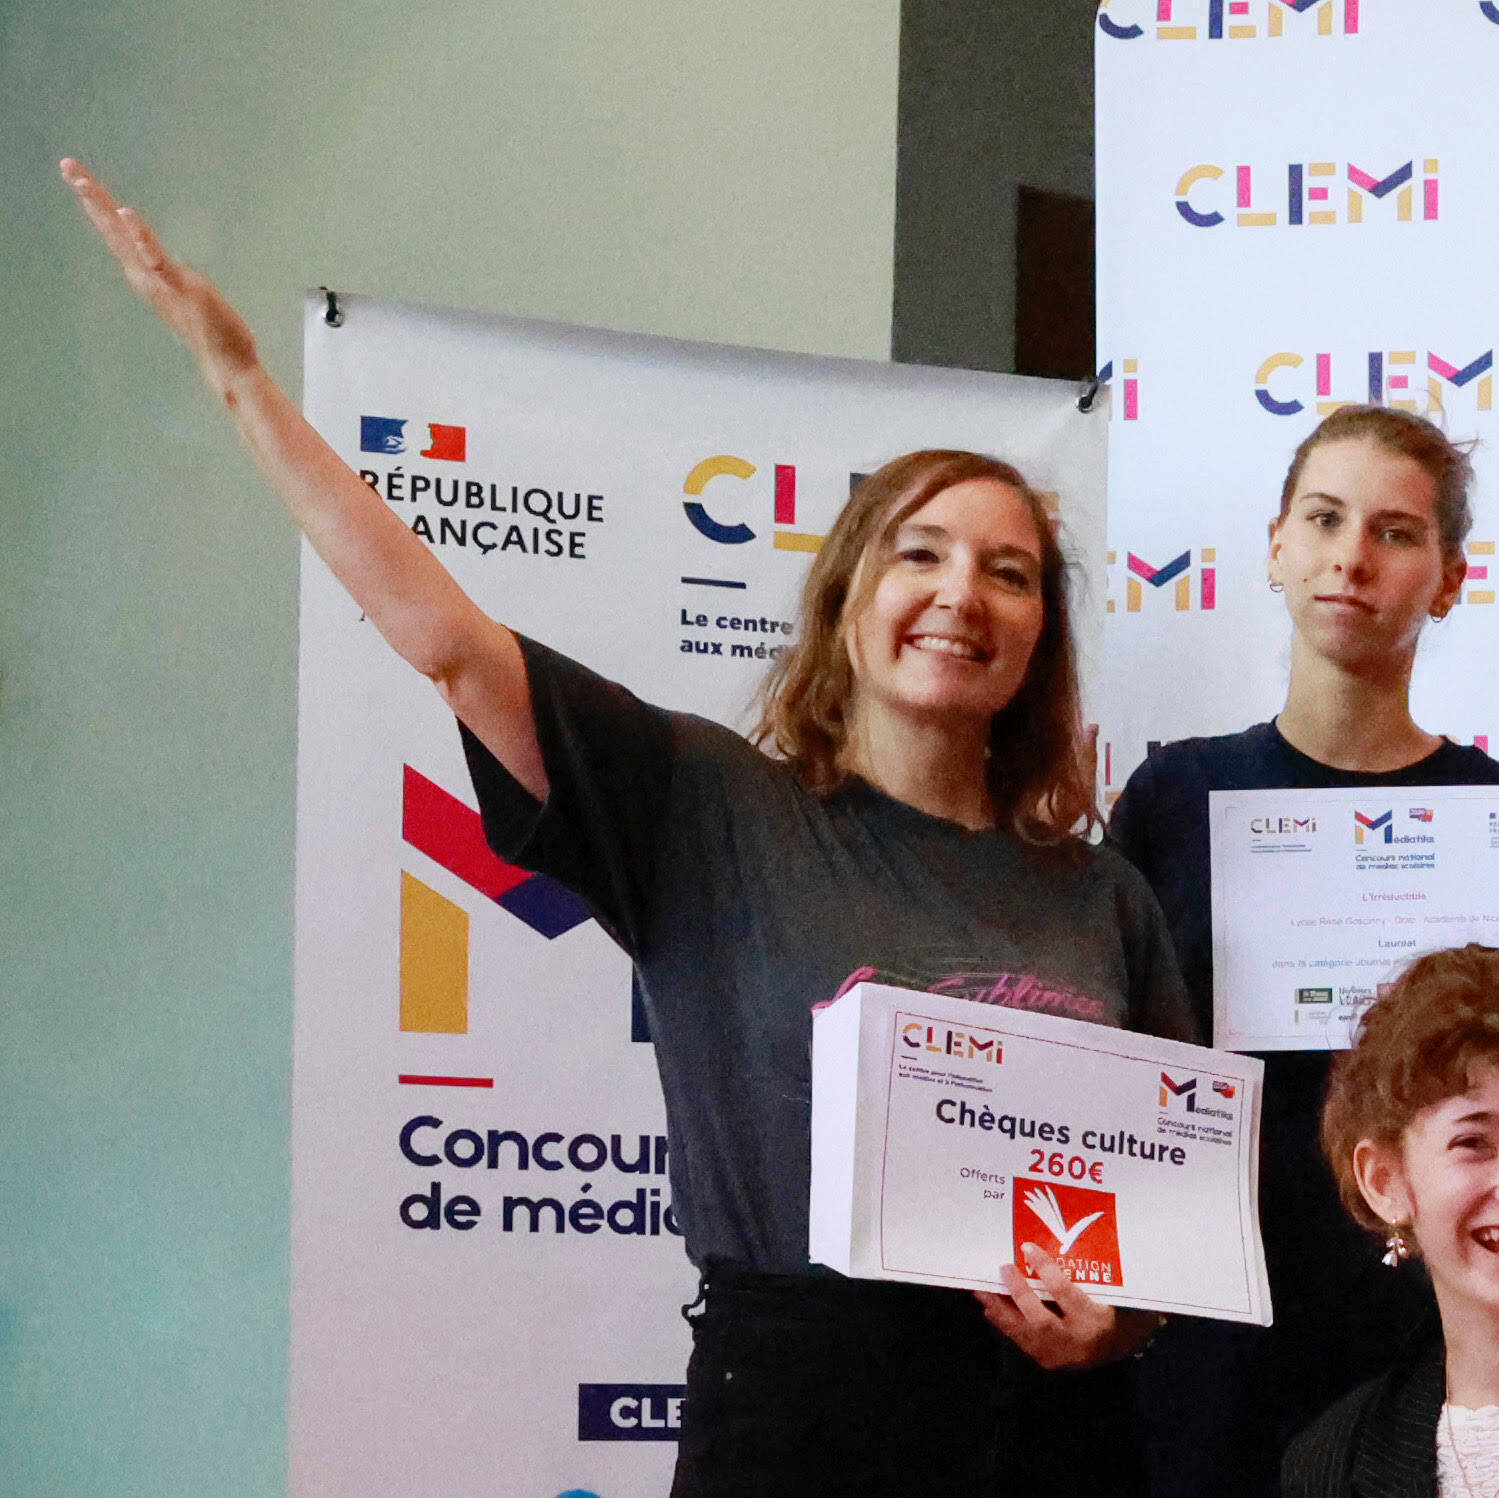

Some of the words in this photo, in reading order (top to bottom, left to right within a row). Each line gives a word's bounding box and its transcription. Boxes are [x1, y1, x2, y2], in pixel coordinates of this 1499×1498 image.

[411, 514, 588, 559] ANÇAISE
[680, 608, 708, 627] Le
[680, 639, 723, 656] aux
[399, 1115, 669, 1175] Concour
[935, 1098, 1071, 1145] Chèques
[1081, 1130, 1186, 1165] culture
[959, 1167, 1006, 1185] Offerts
[1028, 1148, 1105, 1184] 260€
[399, 1181, 481, 1232] de
[502, 1184, 687, 1236] médi
[983, 1190, 1006, 1200] par
[1056, 1256, 1112, 1273] DATION
